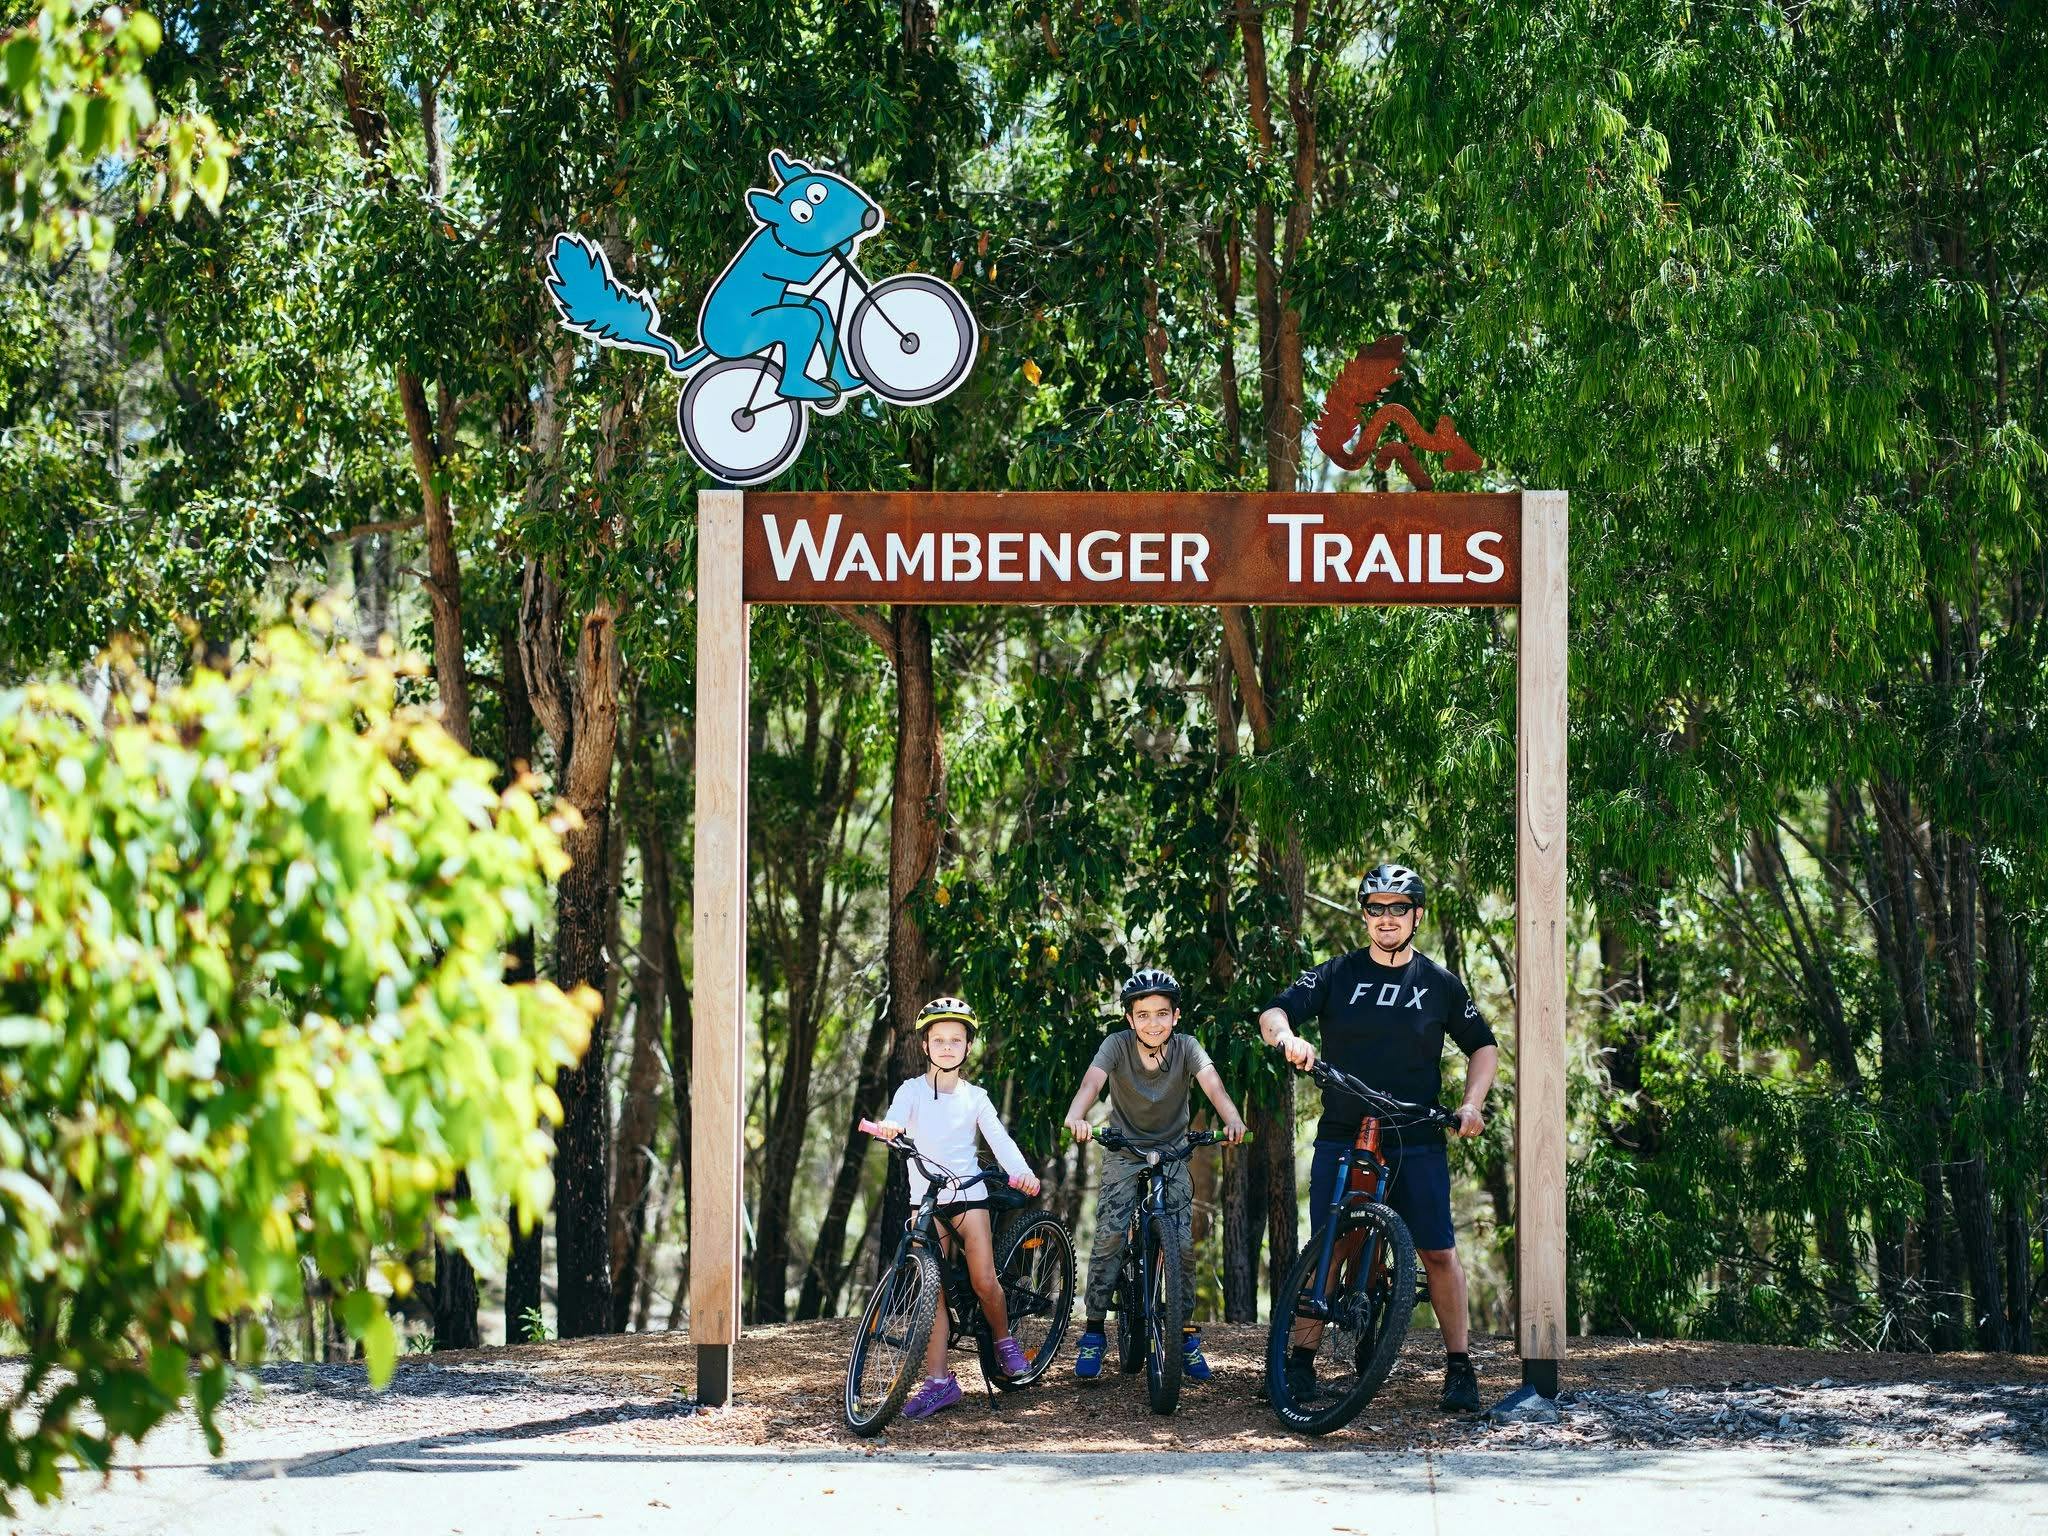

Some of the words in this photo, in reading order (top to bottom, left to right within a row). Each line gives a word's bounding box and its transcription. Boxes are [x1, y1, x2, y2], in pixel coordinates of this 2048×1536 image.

[762, 514, 1210, 582] WAMBENGER
[1267, 513, 1505, 583] TRAILS
[1349, 983, 1429, 1010] FOX
[1282, 1407, 1313, 1421] MAXXIS
